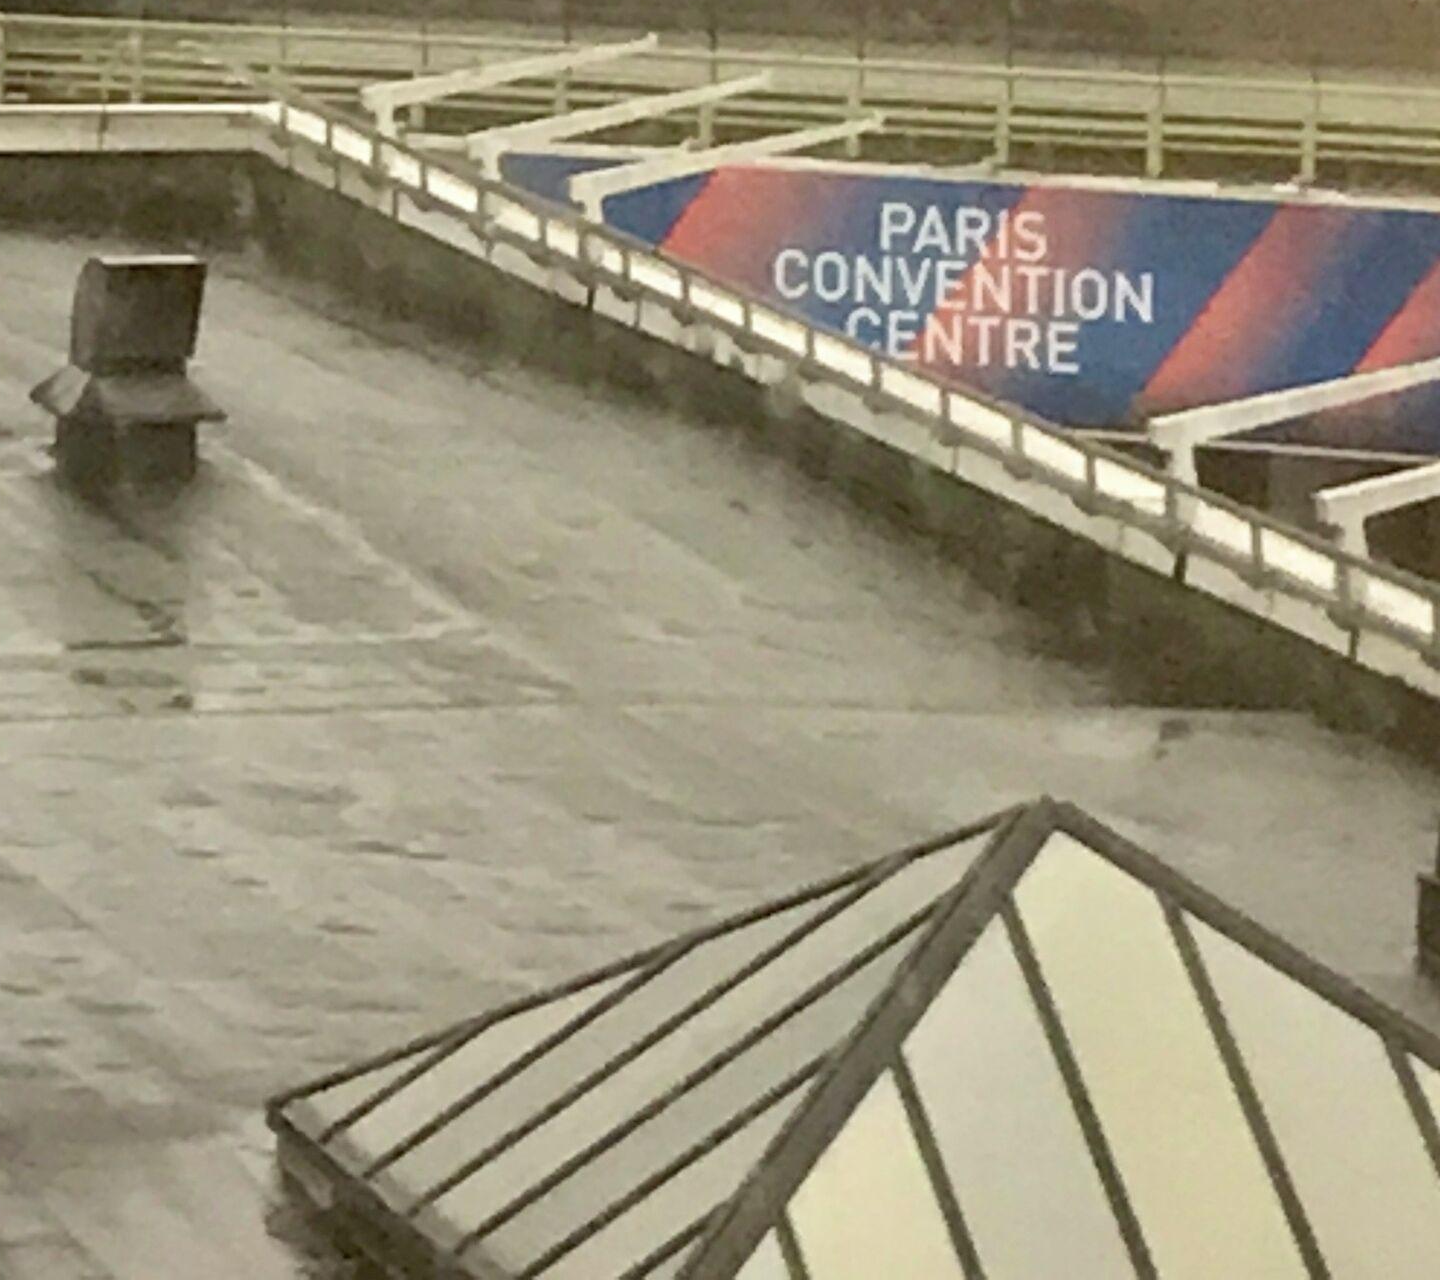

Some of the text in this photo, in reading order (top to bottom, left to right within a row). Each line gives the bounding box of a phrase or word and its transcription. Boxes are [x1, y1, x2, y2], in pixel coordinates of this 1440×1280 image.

[879, 202, 1048, 261] PARIS
[773, 248, 1154, 323] CONVENTION
[845, 307, 1081, 374] CENTRE
